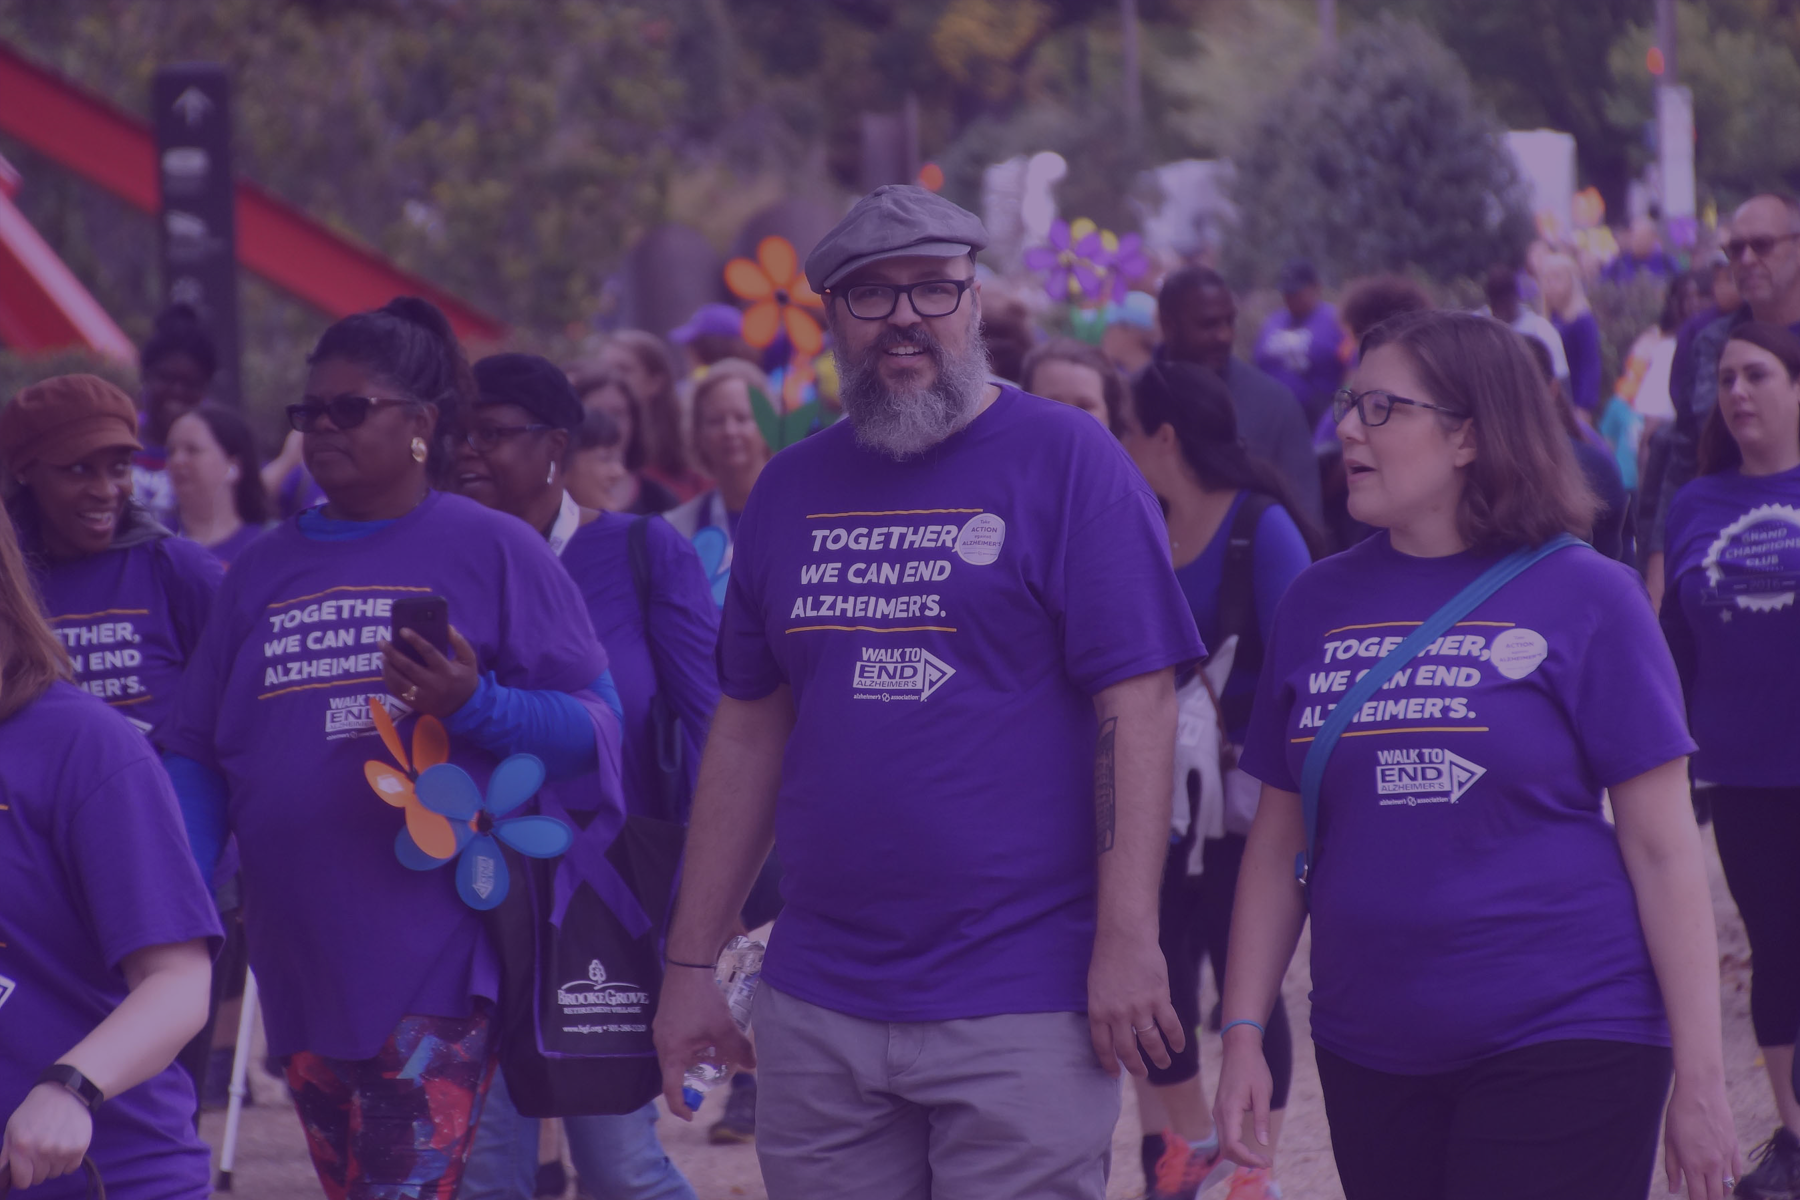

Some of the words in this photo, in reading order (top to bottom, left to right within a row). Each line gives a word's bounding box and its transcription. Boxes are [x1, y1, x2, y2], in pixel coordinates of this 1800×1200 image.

[1745, 554, 1779, 566] CLUB
[801, 562, 842, 585] WE
[847, 562, 901, 585] CAN
[902, 560, 952, 583] END
[269, 598, 396, 633] TOGETHE
[790, 594, 947, 619] ALZHEIMER'S.
[263, 634, 302, 658] WE
[306, 628, 355, 650] CAN
[360, 625, 392, 644] EN
[1323, 635, 1490, 664] TOGEHER,
[88, 648, 141, 672] END
[862, 647, 903, 662] WALK
[904, 647, 921, 662] TO
[857, 664, 919, 680] END
[1308, 670, 1351, 694] WE
[1414, 665, 1481, 687] END
[855, 680, 917, 688] ALZHEIMER'S
[329, 694, 367, 710] WALK
[1299, 697, 1477, 729] ALEIMER'S.
[1377, 748, 1420, 765] WALK
[1421, 748, 1443, 763] TO
[1380, 766, 1444, 783] END
[1381, 782, 1445, 792] ALZHEIMER'S
